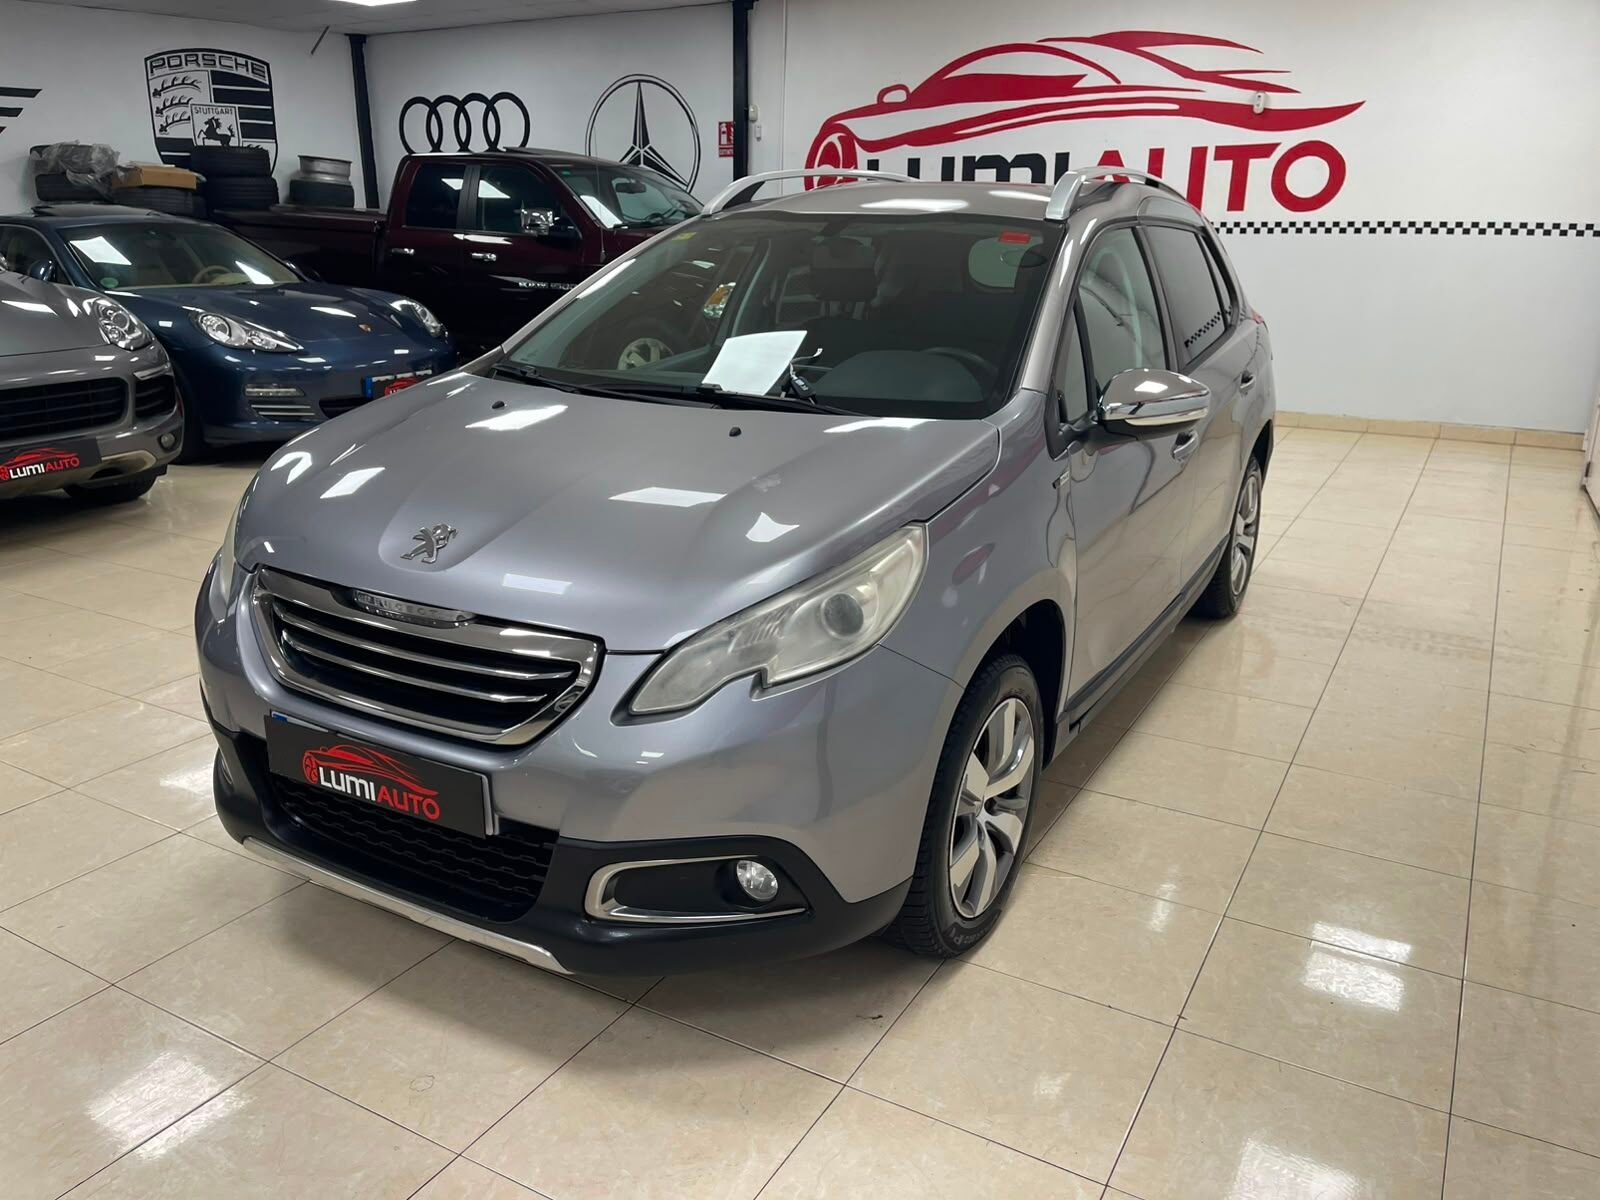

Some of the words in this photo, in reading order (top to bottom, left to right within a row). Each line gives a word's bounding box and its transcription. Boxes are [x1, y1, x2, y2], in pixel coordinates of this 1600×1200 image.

[150, 53, 267, 80] PORSCHE
[194, 106, 233, 115] STUTTGART
[318, 766, 441, 821] LUMIAUTO
